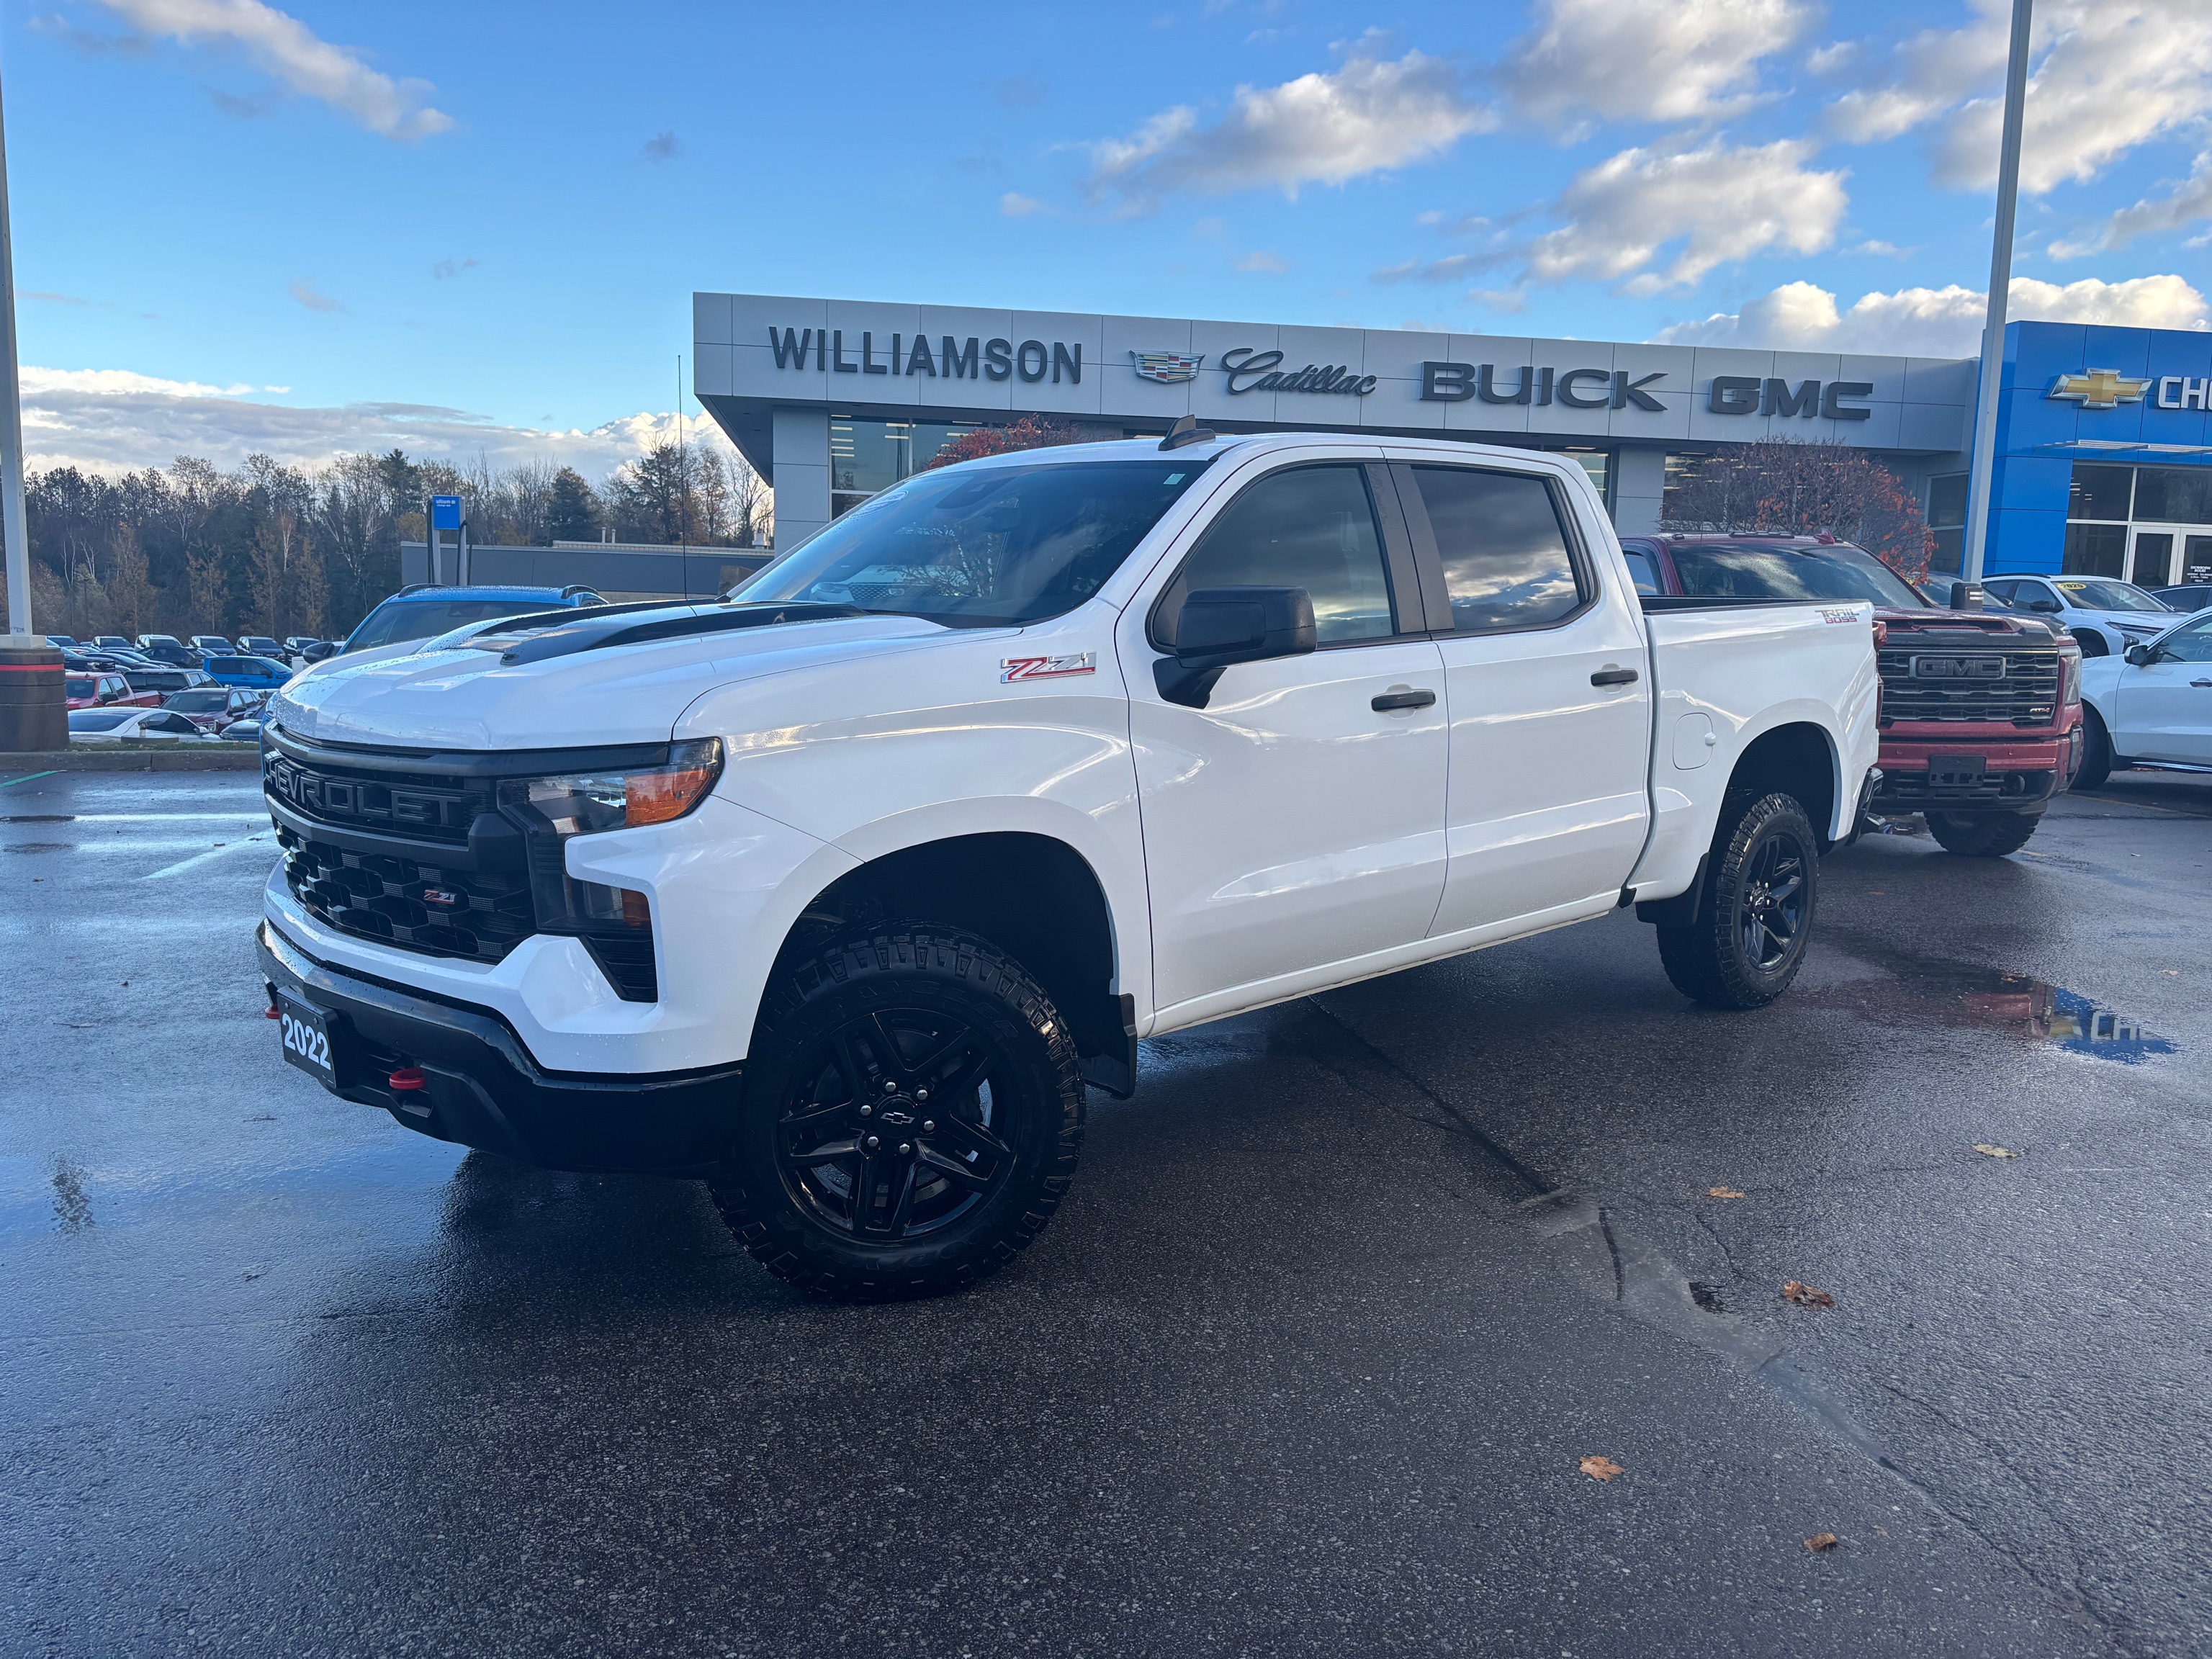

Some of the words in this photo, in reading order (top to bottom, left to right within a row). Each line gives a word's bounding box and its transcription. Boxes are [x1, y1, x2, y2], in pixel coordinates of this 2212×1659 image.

[768, 326, 1082, 384] WILLIAMSON
[1220, 348, 1377, 396] Cadillac
[1419, 361, 1669, 411] BUICK
[1709, 376, 1874, 421] GMC
[1815, 608, 1859, 618] TRAIL
[1825, 616, 1857, 624] BOSS
[1001, 650, 1097, 684] Z71
[1917, 659, 2001, 676] GMC
[264, 752, 469, 826] CHEVROLET
[423, 889, 457, 905] Z71
[282, 1012, 329, 1071] 2022
